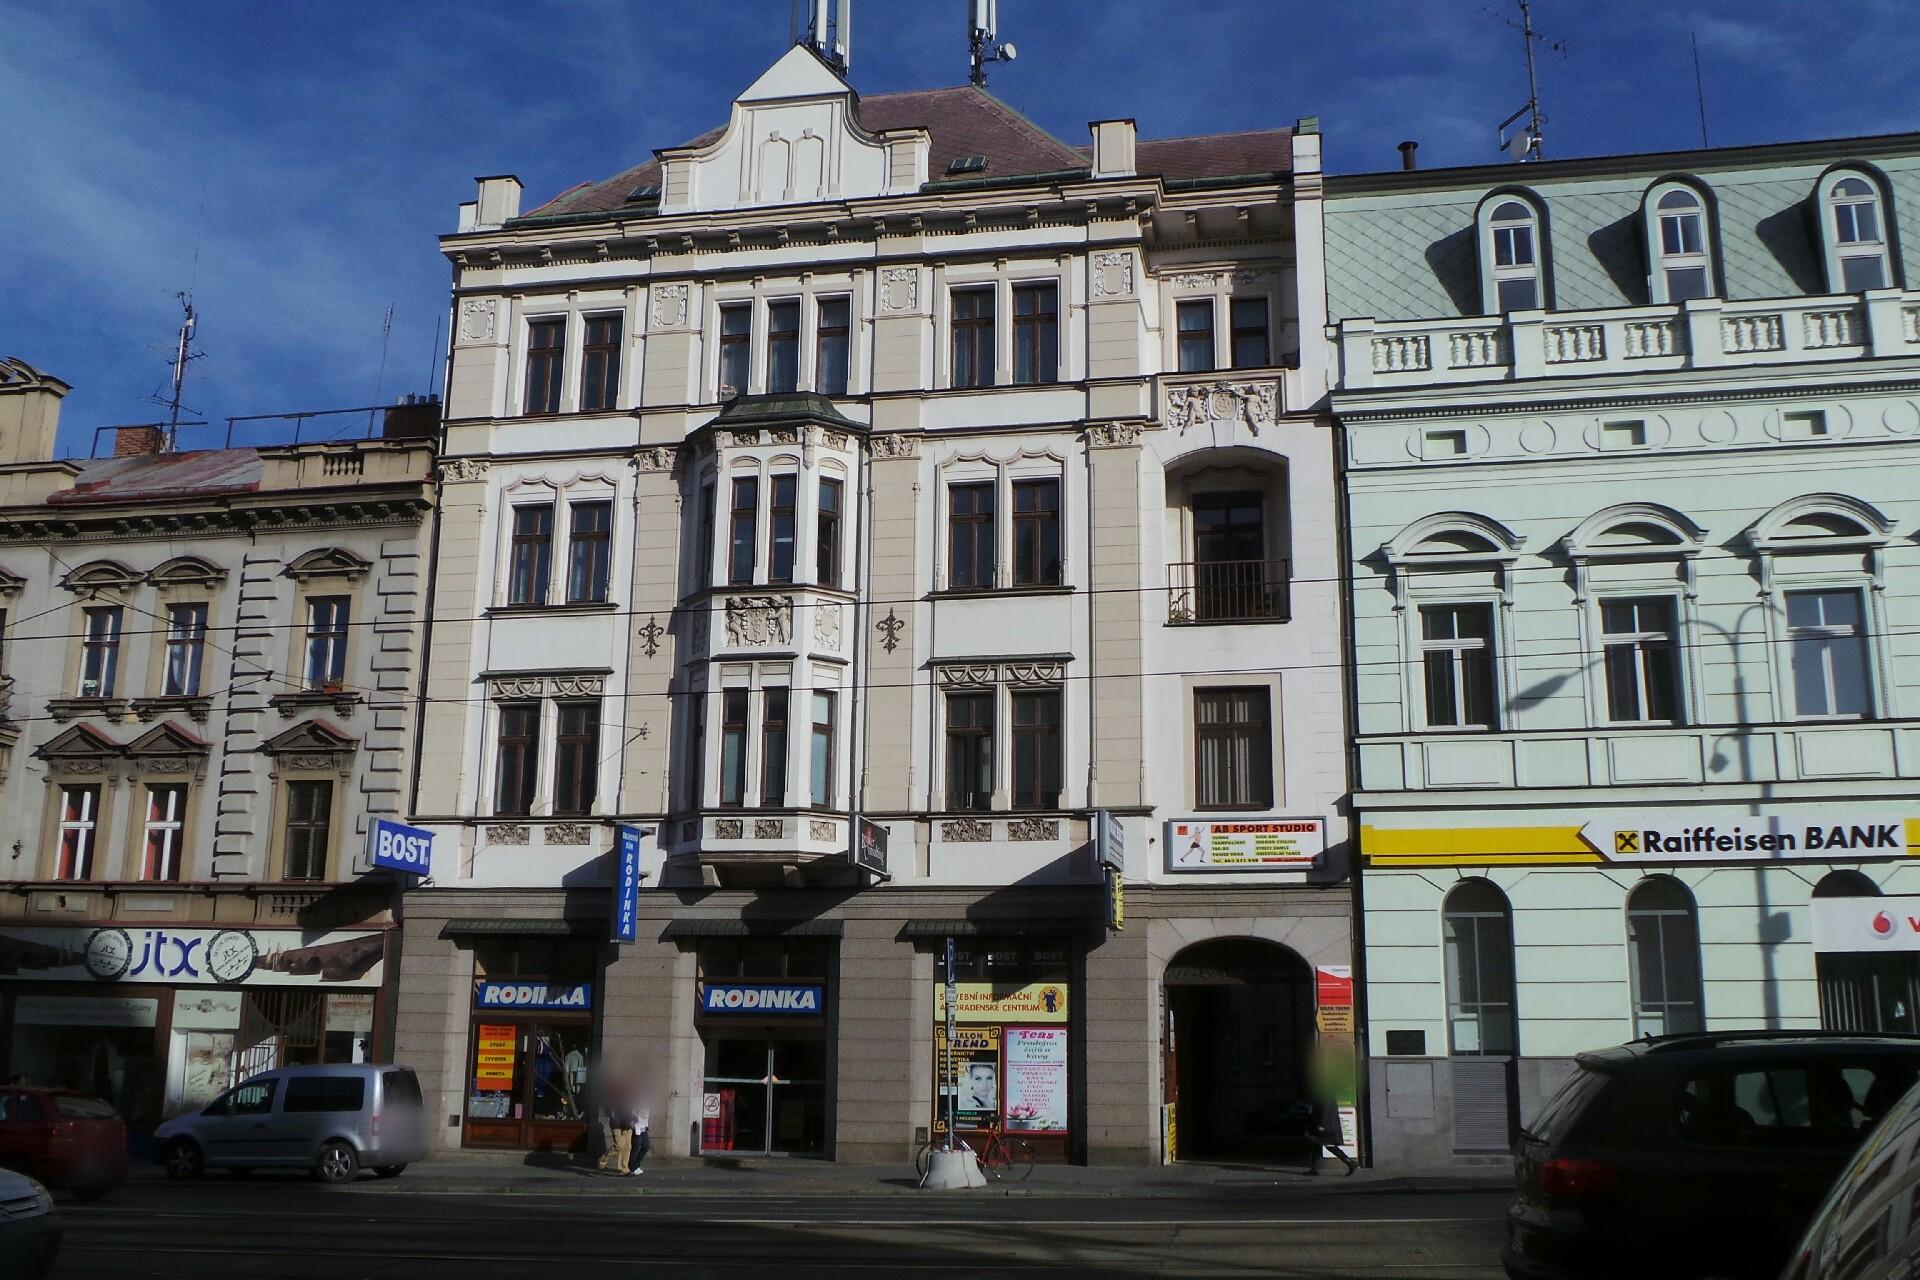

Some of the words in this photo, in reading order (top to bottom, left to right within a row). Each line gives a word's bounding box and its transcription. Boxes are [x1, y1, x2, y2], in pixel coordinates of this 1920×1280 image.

[1214, 825, 1229, 833] AB
[1233, 824, 1268, 832] SPORT
[1272, 823, 1315, 832] STUDIO
[378, 829, 429, 865] BOST
[1643, 827, 1796, 853] Raiffeisen
[1805, 824, 1899, 850] BANK
[130, 931, 201, 976] jtx
[484, 986, 584, 1005] RODINKA
[709, 989, 815, 1009] RODINKA
[1003, 1004, 1040, 1012] CENTRUM
